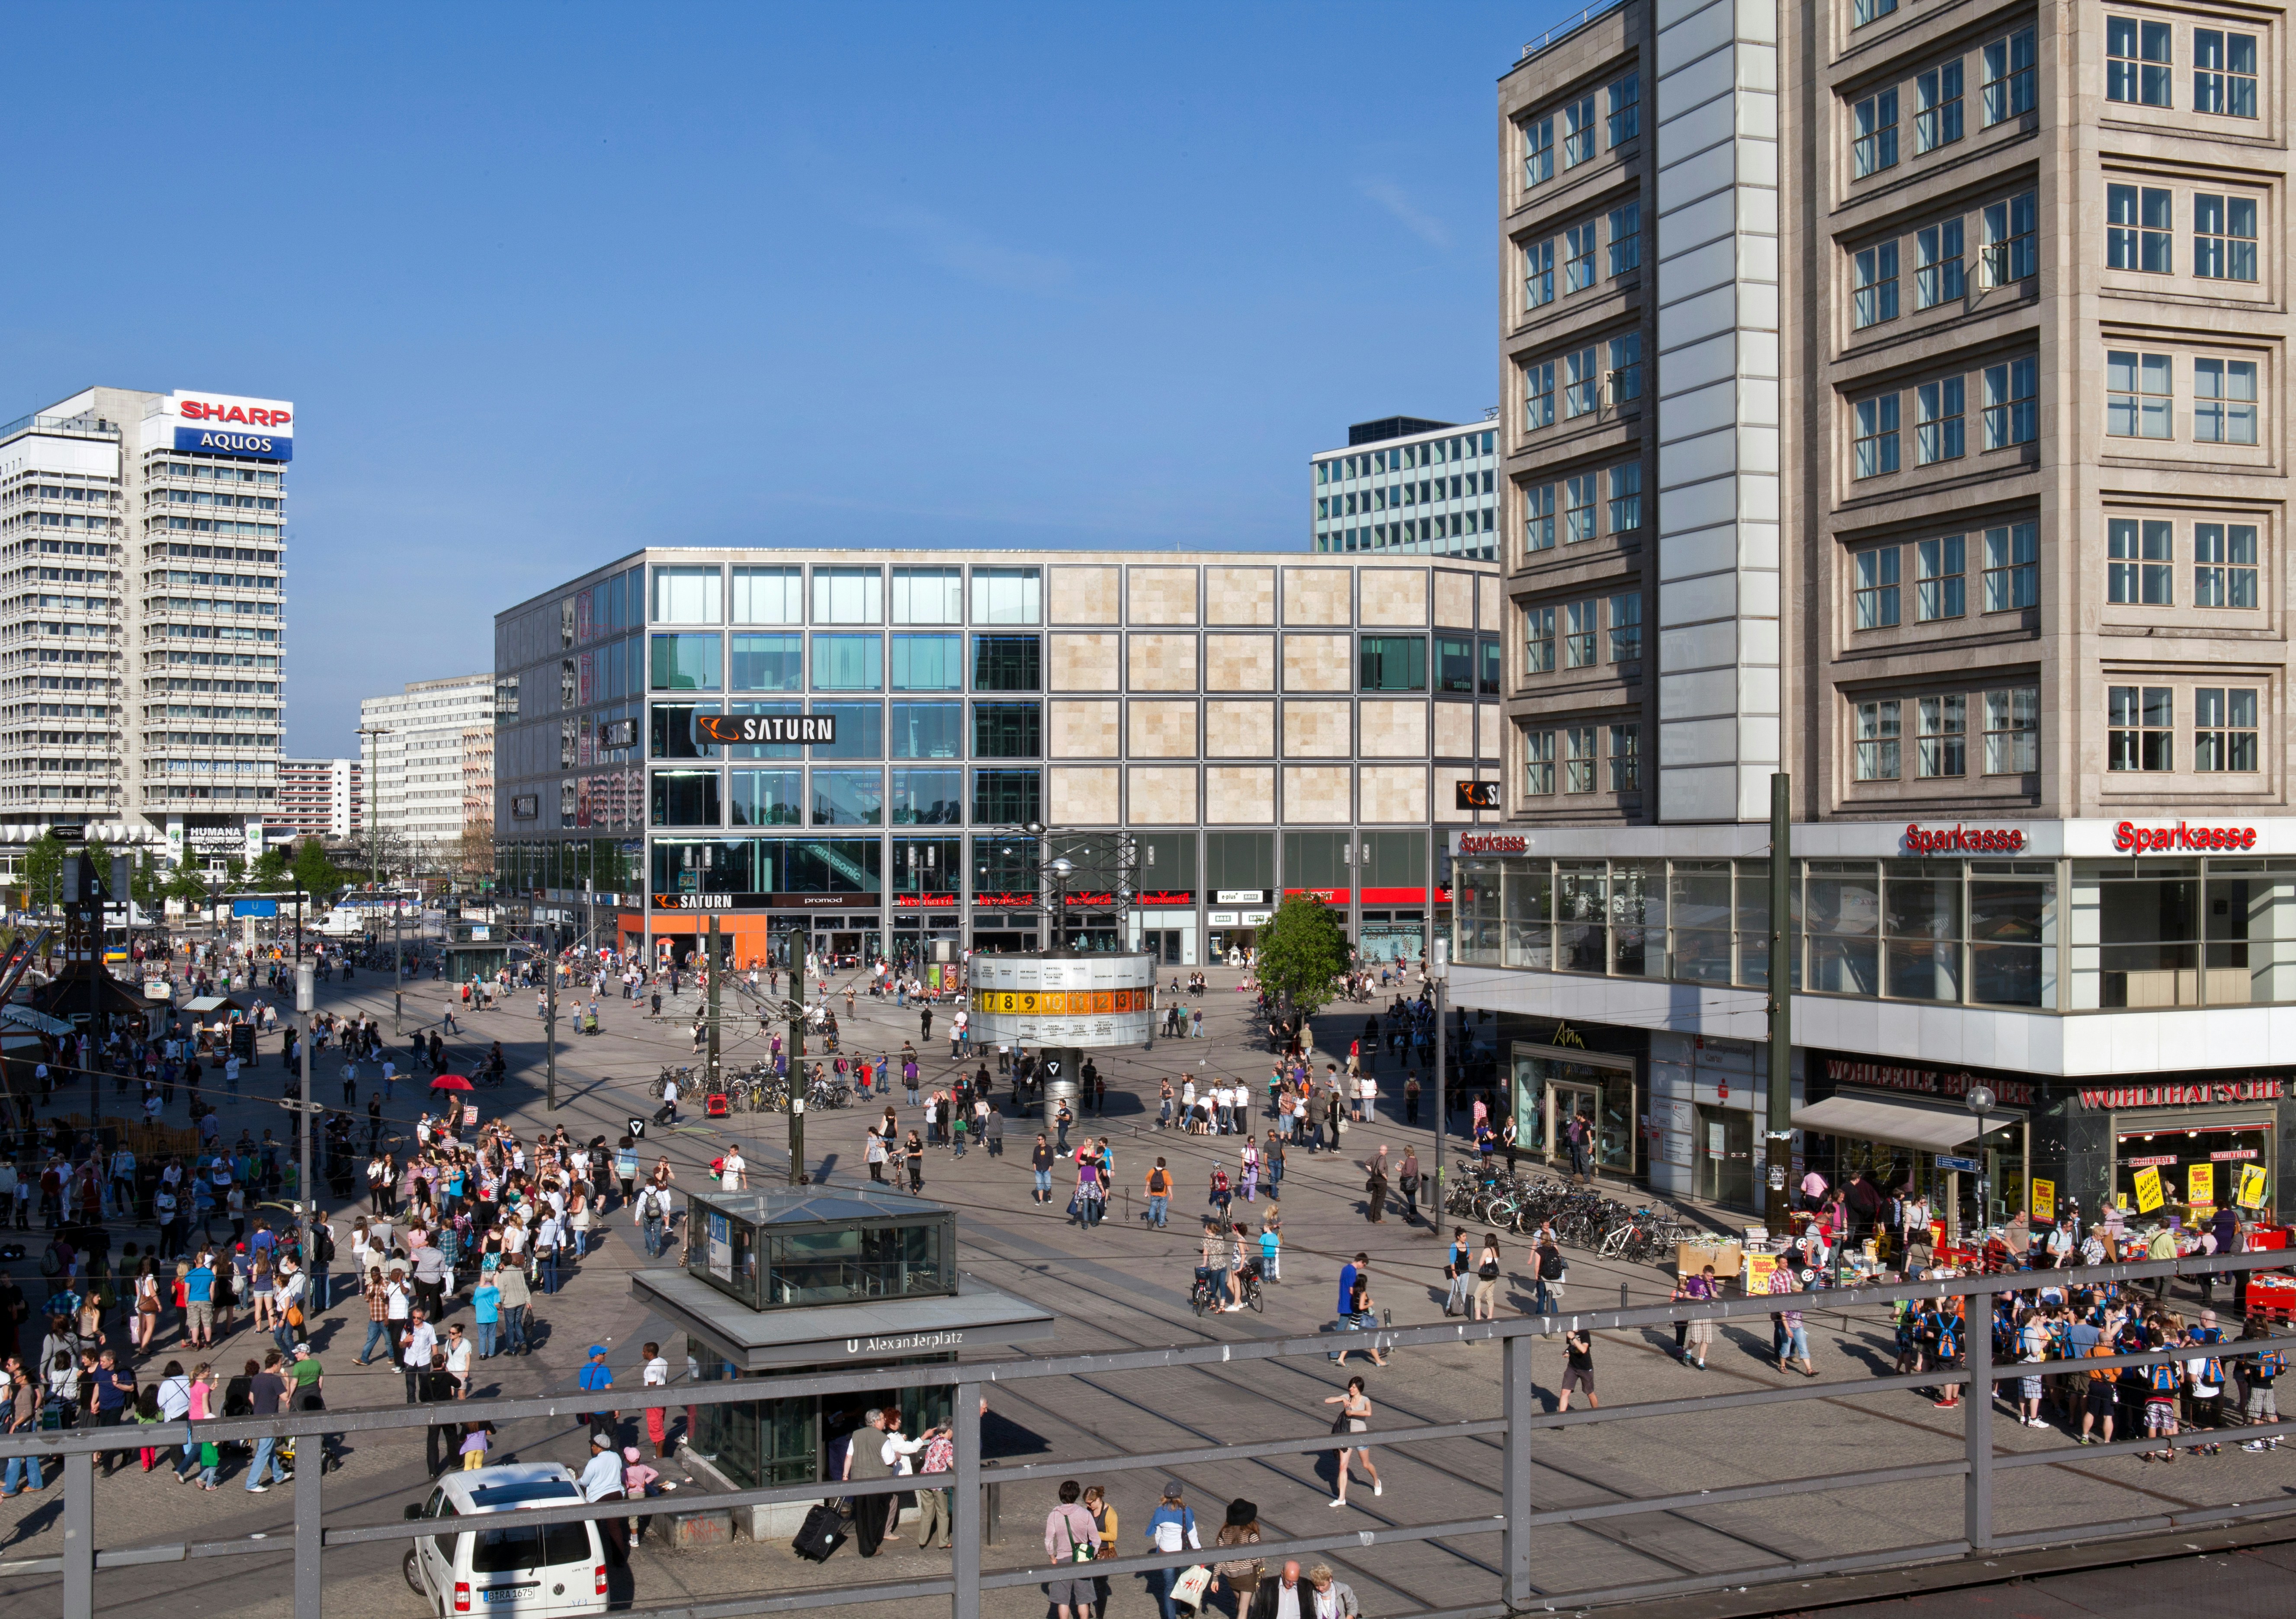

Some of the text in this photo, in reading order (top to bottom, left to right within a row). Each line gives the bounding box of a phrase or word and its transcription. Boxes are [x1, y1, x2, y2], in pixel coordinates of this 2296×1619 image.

[180, 400, 291, 427] SHARP
[200, 432, 272, 452] AQUOS
[744, 718, 832, 740] SATURN
[190, 828, 241, 836] HUMANA
[1906, 824, 2023, 854] Sparkasse
[2117, 821, 2257, 854] Sparkasse
[1461, 832, 1526, 855] Sparkasse
[252, 902, 259, 910] U
[680, 895, 732, 908] SATURN
[988, 994, 995, 1008] 7
[1004, 995, 1013, 1009] 8
[1024, 995, 1035, 1010] 9
[1044, 995, 1063, 1010] 10
[1069, 995, 1084, 1010] 11
[1093, 995, 1108, 1009] 12
[1115, 993, 1127, 1008] 13
[1825, 1059, 1936, 1091] WOHLFEILE
[1943, 1071, 2033, 1104] BÜCHER
[2079, 1077, 2285, 1109] WOHLTHAT'SCHE
[2212, 1151, 2249, 1159] WOHLTHAT
[2037, 1189, 2051, 1198] Bücher
[2140, 1172, 2157, 1194] Alles
[2142, 1181, 2158, 1201] muss
[2146, 1191, 2160, 1208] raus
[711, 1214, 716, 1237] U
[847, 1331, 962, 1353] U Alexanderplatz
[489, 1588, 533, 1600] B RA 1675
